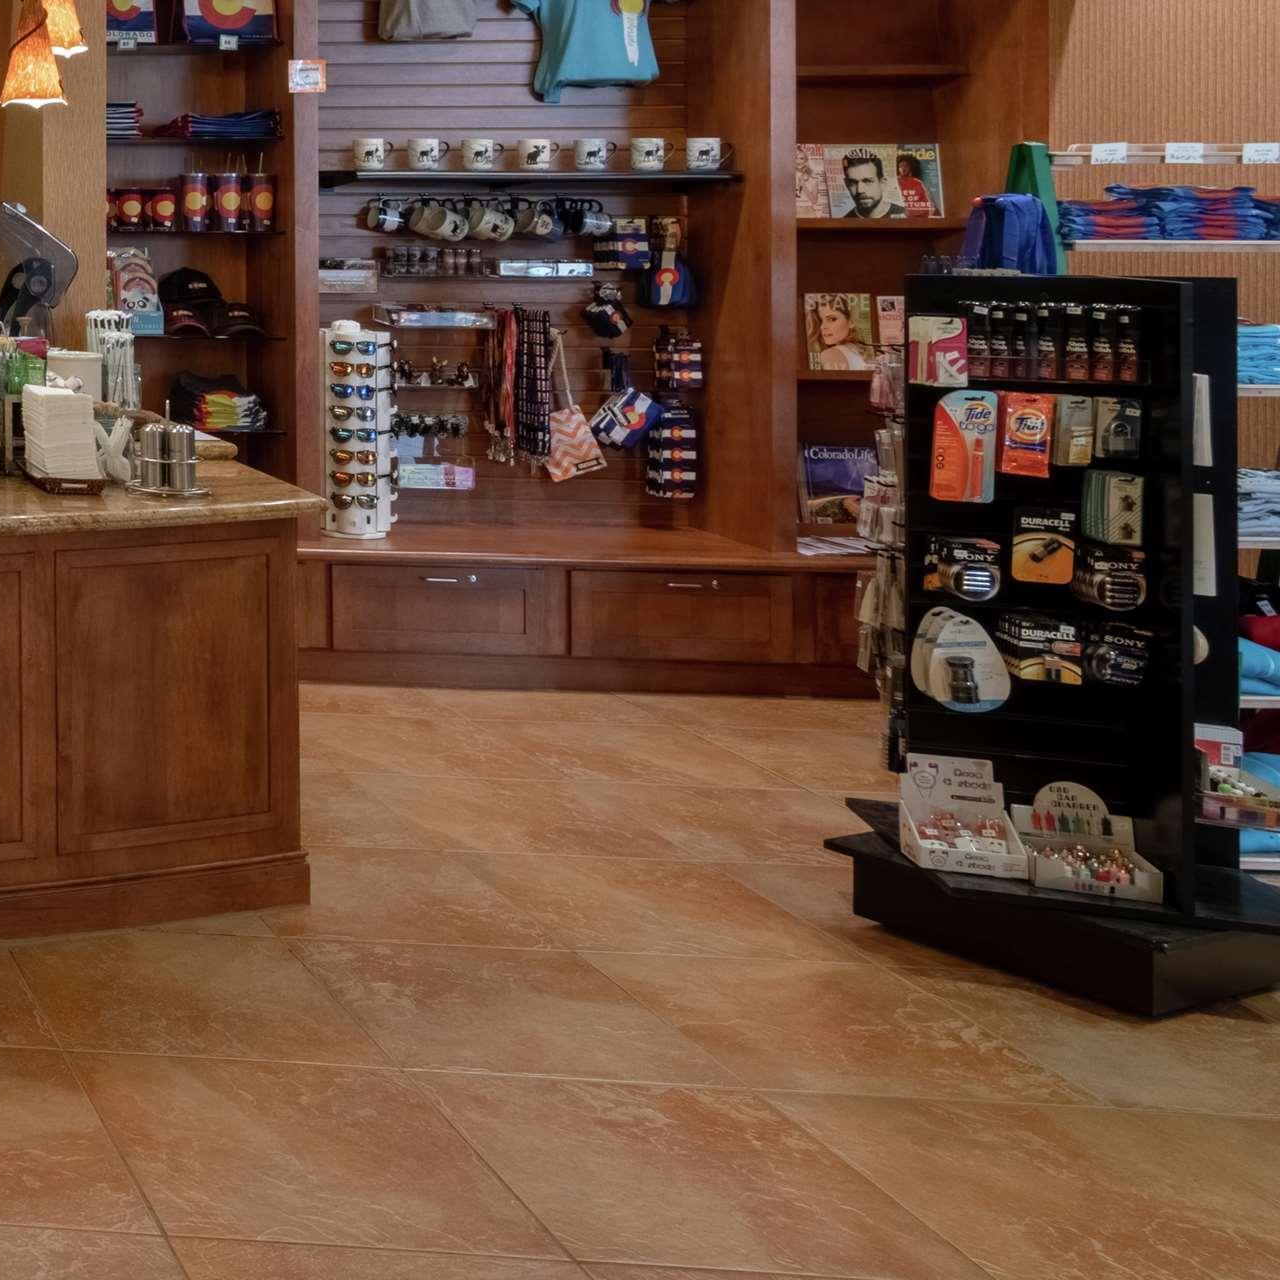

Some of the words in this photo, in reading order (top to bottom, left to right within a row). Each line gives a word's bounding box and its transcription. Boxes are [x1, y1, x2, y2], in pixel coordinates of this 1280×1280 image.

[107, 31, 153, 39] OLORADO
[805, 293, 871, 311] SHAPE
[965, 407, 992, 421] Tide
[1020, 516, 1071, 528] DURACELL
[1107, 562, 1140, 570] ONY
[1021, 628, 1076, 641] DURACELL
[1103, 634, 1146, 649] SONY
